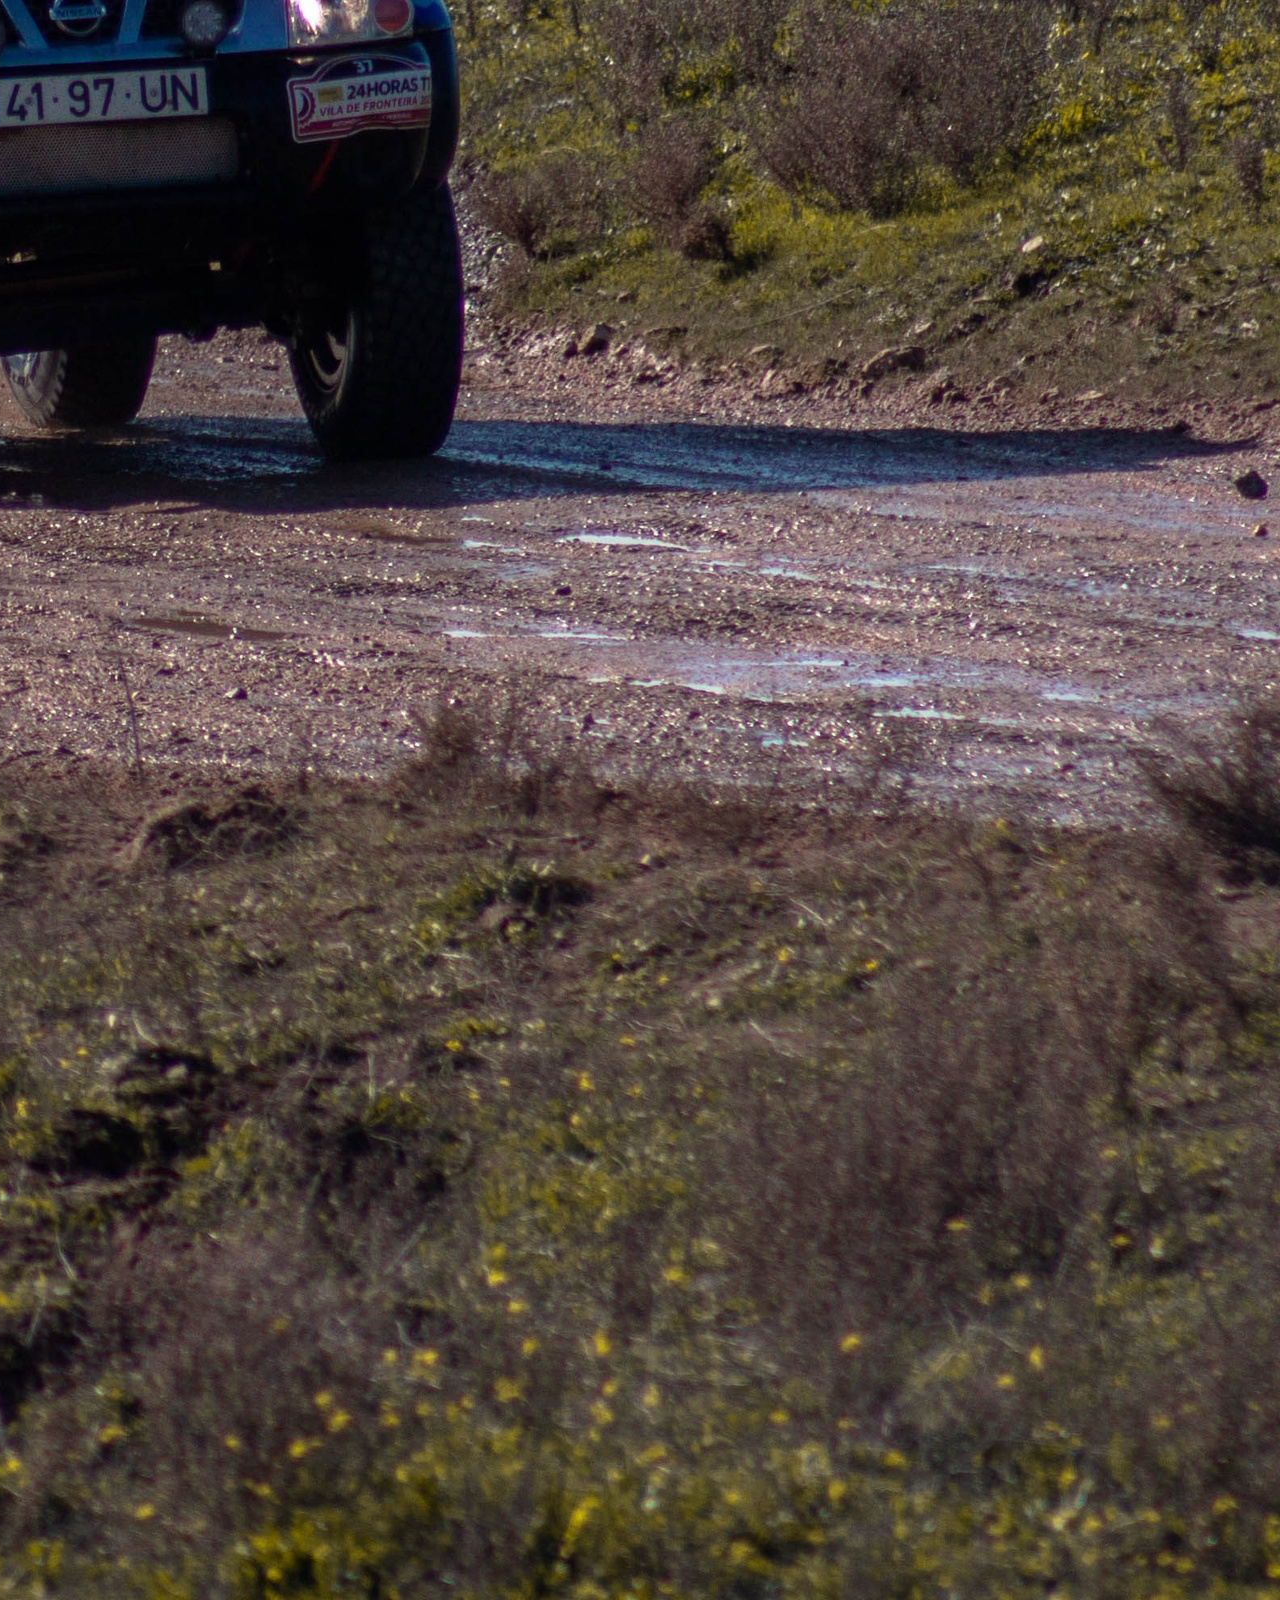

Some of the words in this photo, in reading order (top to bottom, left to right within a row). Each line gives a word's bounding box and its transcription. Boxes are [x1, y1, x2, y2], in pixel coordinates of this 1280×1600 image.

[352, 59, 375, 74] 37
[347, 78, 418, 100] 24HORAS
[320, 106, 343, 117] VILA
[346, 103, 360, 113] DE
[363, 97, 418, 111] FRONTEIRA
